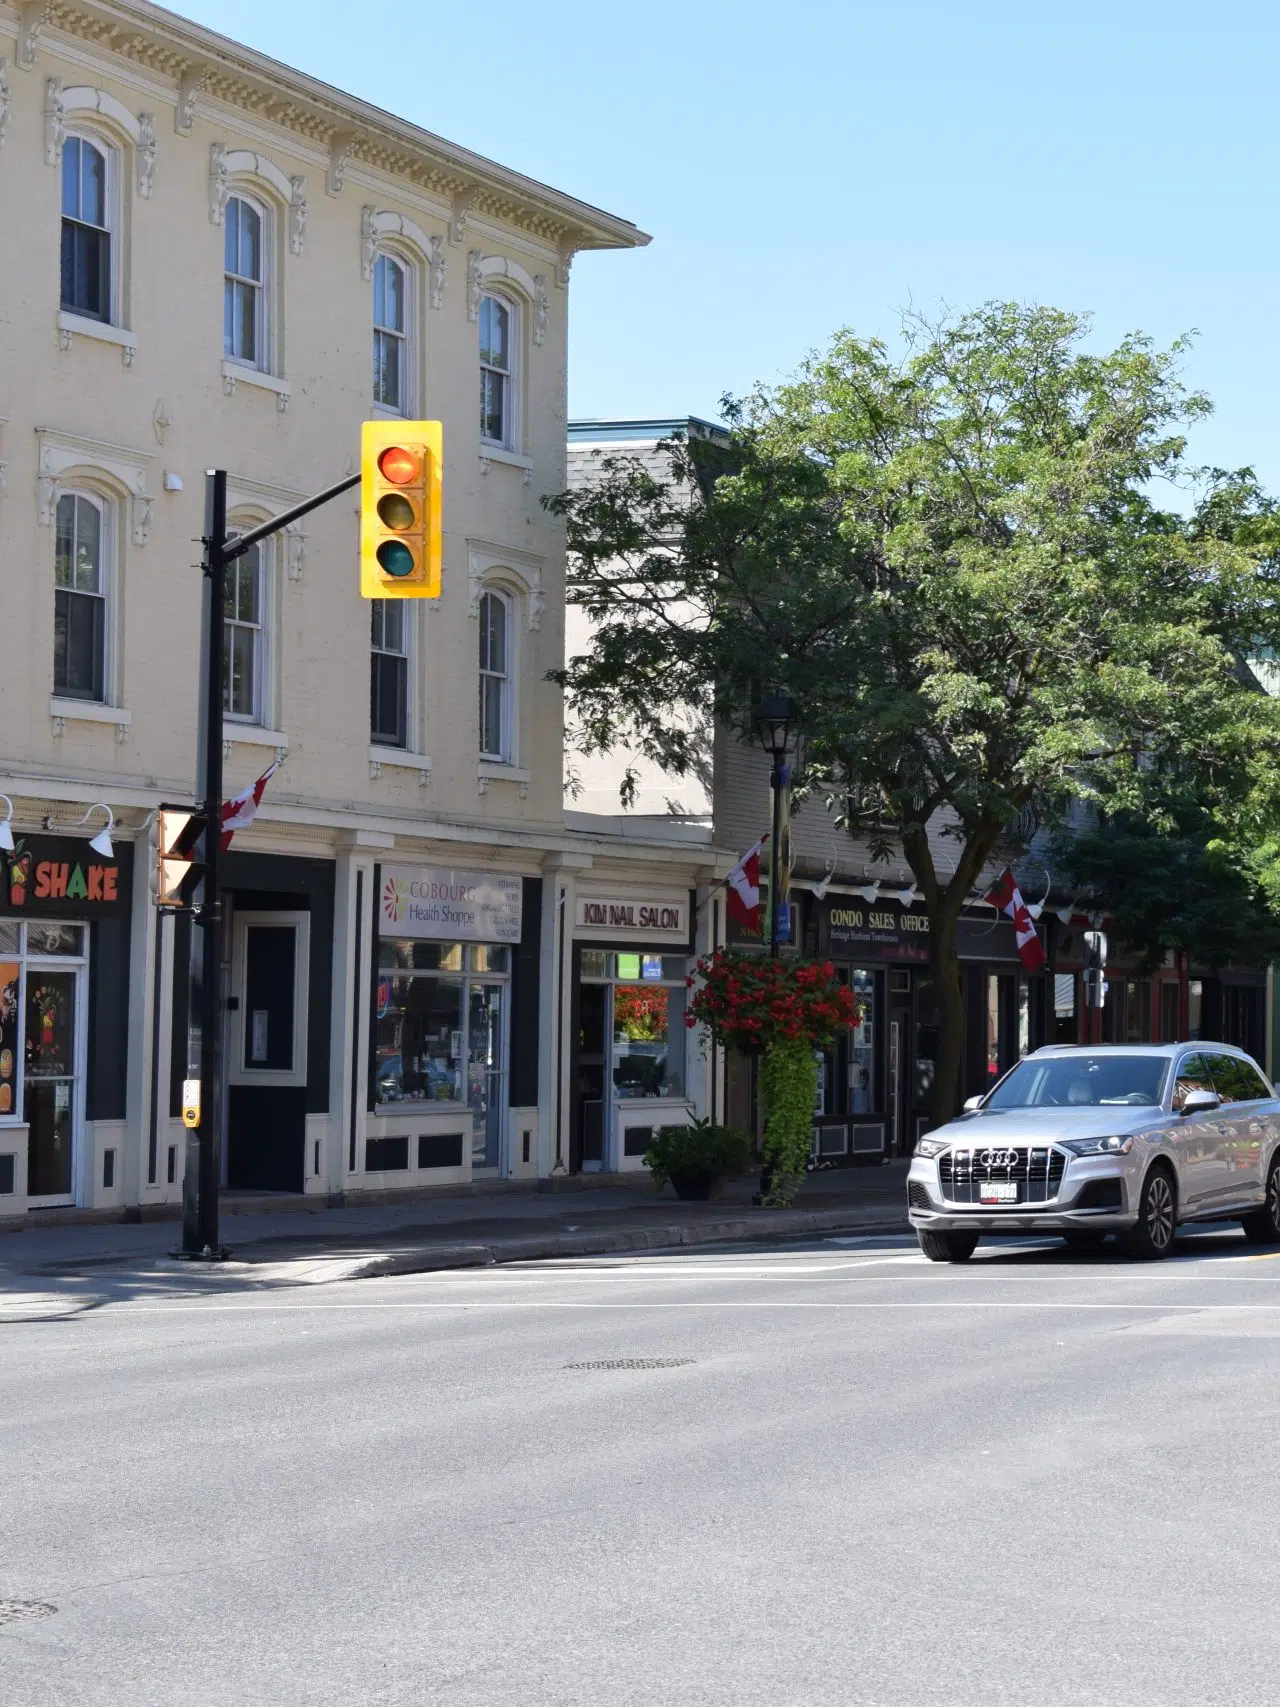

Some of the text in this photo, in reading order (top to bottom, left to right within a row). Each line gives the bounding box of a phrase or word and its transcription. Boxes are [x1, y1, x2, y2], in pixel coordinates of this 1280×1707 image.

[34, 860, 118, 901] SHAKE
[410, 881, 476, 903] COBOURG
[409, 903, 475, 926] Health Shoppe
[584, 903, 679, 929] KIM NAIL SALON
[830, 909, 930, 932] CONDO SALES OFFICE
